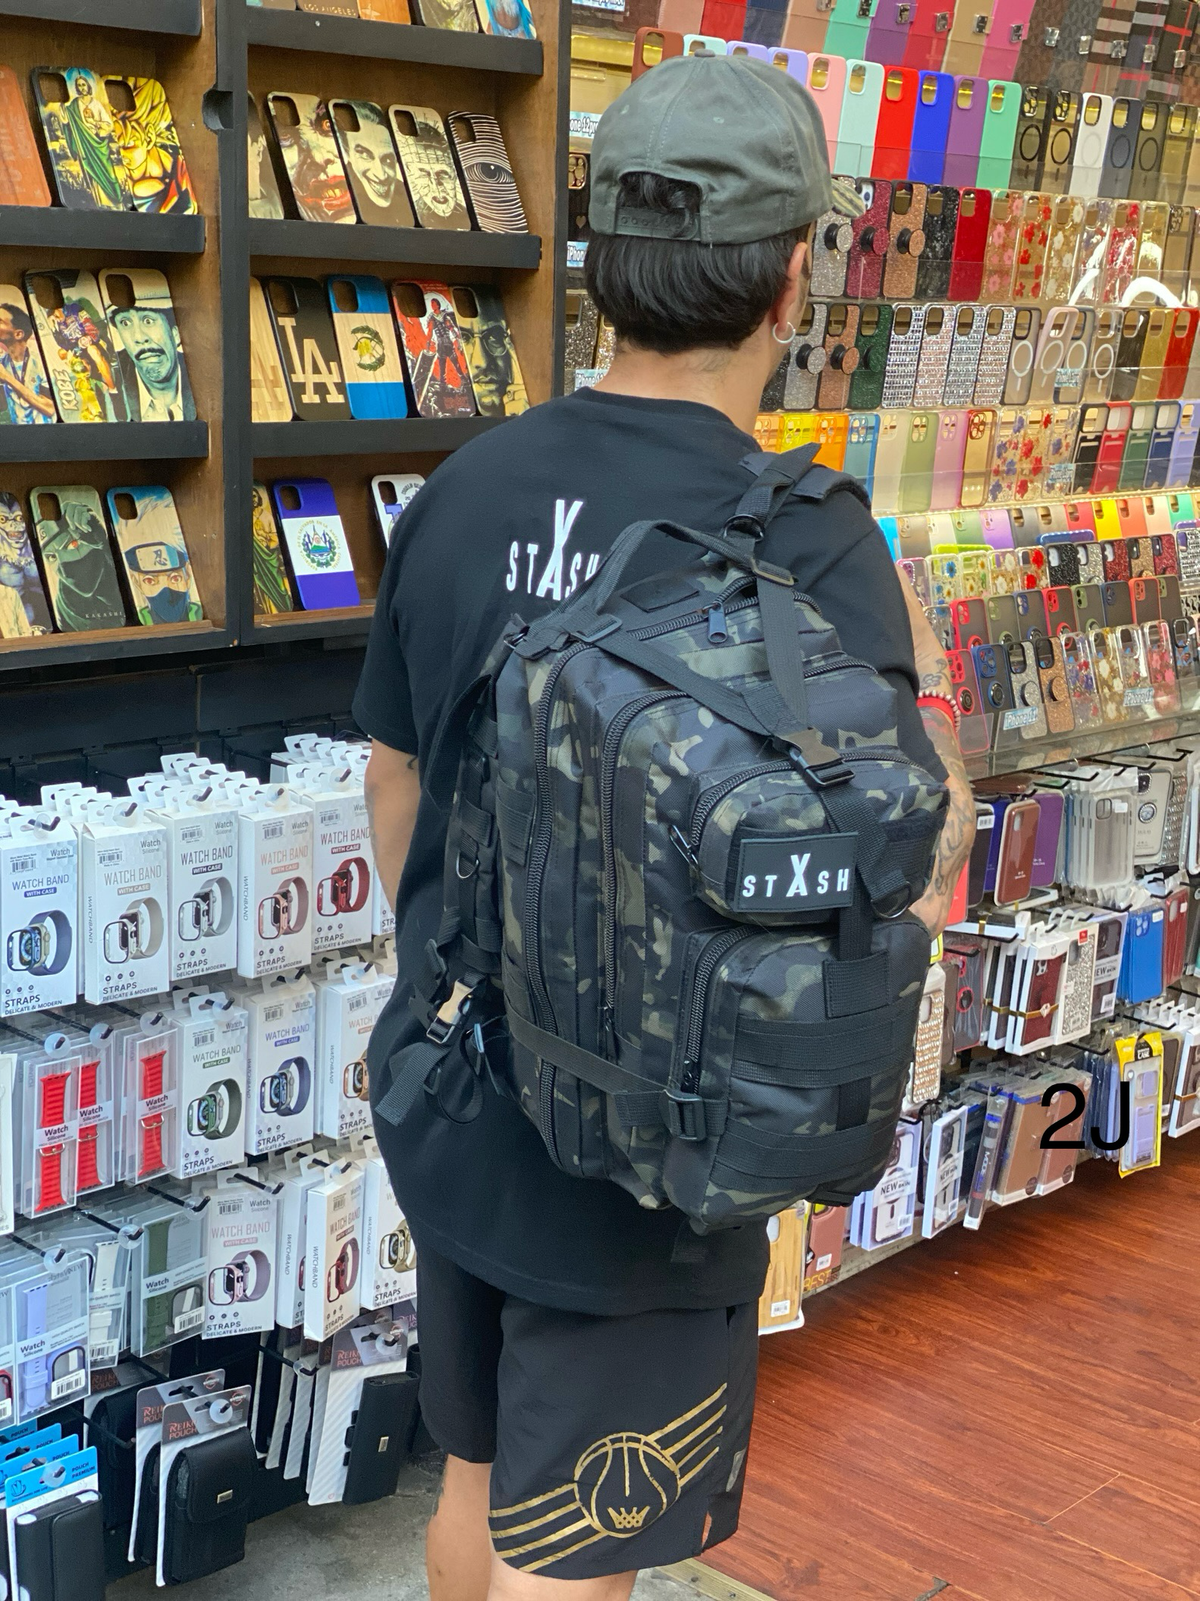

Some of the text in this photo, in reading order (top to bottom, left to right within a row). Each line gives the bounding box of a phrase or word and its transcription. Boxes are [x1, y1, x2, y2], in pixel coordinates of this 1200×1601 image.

[278, 317, 345, 403] LA
[53, 368, 79, 411] KOBE
[215, 820, 234, 830] Watch
[292, 820, 309, 830] Watch
[140, 839, 161, 848] Watch
[320, 830, 348, 846] WATCH
[50, 848, 70, 856] Watch
[181, 845, 234, 866] WATCH BAND
[260, 845, 309, 866] WATCH BAND
[104, 865, 162, 886] WATCH BAND
[193, 867, 206, 875] WITH
[12, 874, 70, 891] WATCH BAND
[26, 890, 42, 898] WITH
[119, 888, 133, 896] WITH
[314, 932, 344, 944] STRAPS
[176, 958, 208, 972] STRAPS
[256, 956, 286, 969] STRAPS
[176, 968, 200, 978] DELICATE
[206, 963, 227, 972] MODERN
[102, 982, 138, 995] STRAPS
[103, 991, 129, 1002] DELICATE
[135, 986, 158, 995] MODERN
[4, 994, 41, 1008] STRAPS
[4, 1006, 30, 1015] DELICATE
[38, 1000, 62, 1010] MODERN
[348, 1016, 372, 1028] WATCH
[265, 1024, 310, 1041] WATCH BAND
[192, 1044, 241, 1063] WATCH BAND
[146, 1094, 168, 1107] Watch
[80, 1105, 104, 1118] Watch
[44, 1125, 68, 1136] Watch
[340, 1117, 367, 1132] STRAPS
[258, 1133, 286, 1147] STRAPS
[283, 1138, 302, 1146] MODERN
[184, 1156, 214, 1170] STRAPS
[184, 1168, 206, 1176] DELICATE
[212, 1160, 232, 1168] MODERN
[880, 1181, 898, 1195] NEW
[250, 1199, 270, 1208] Watch
[211, 1221, 270, 1238] WATCH BAND
[146, 1278, 169, 1289] Watch
[375, 1288, 401, 1301] STRAPS
[206, 1321, 242, 1332] STRAPS
[325, 1314, 344, 1332] STRAPS
[206, 1329, 233, 1338] DELICATE
[20, 1340, 46, 1354] Watch
[11, 1427, 28, 1438] POUCH
[169, 1428, 198, 1440] POUCH
[52, 1450, 70, 1461] POUCH
[72, 1462, 90, 1472] POUCH
[72, 1466, 96, 1478] PREMIUM
